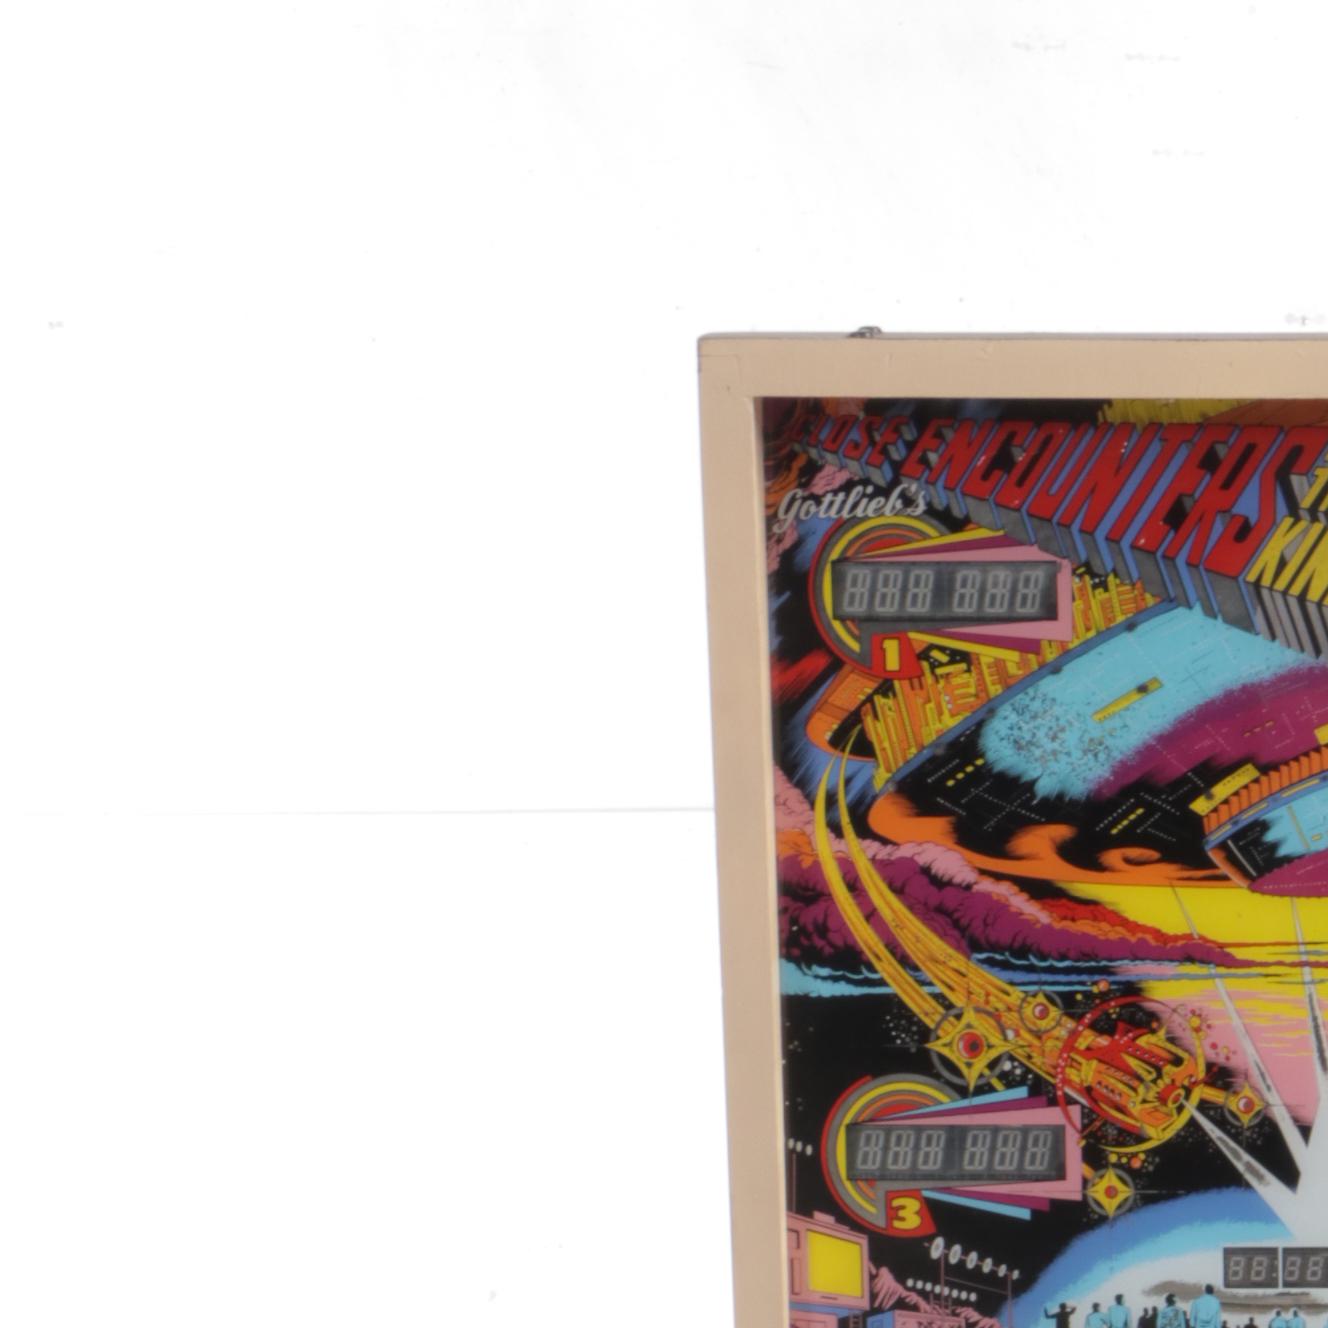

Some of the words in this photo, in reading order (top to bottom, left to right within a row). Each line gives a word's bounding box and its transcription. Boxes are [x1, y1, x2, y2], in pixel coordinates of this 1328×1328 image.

[772, 483, 927, 534] Gottlieb's
[882, 638, 900, 672] 1
[891, 1196, 921, 1230] 3
